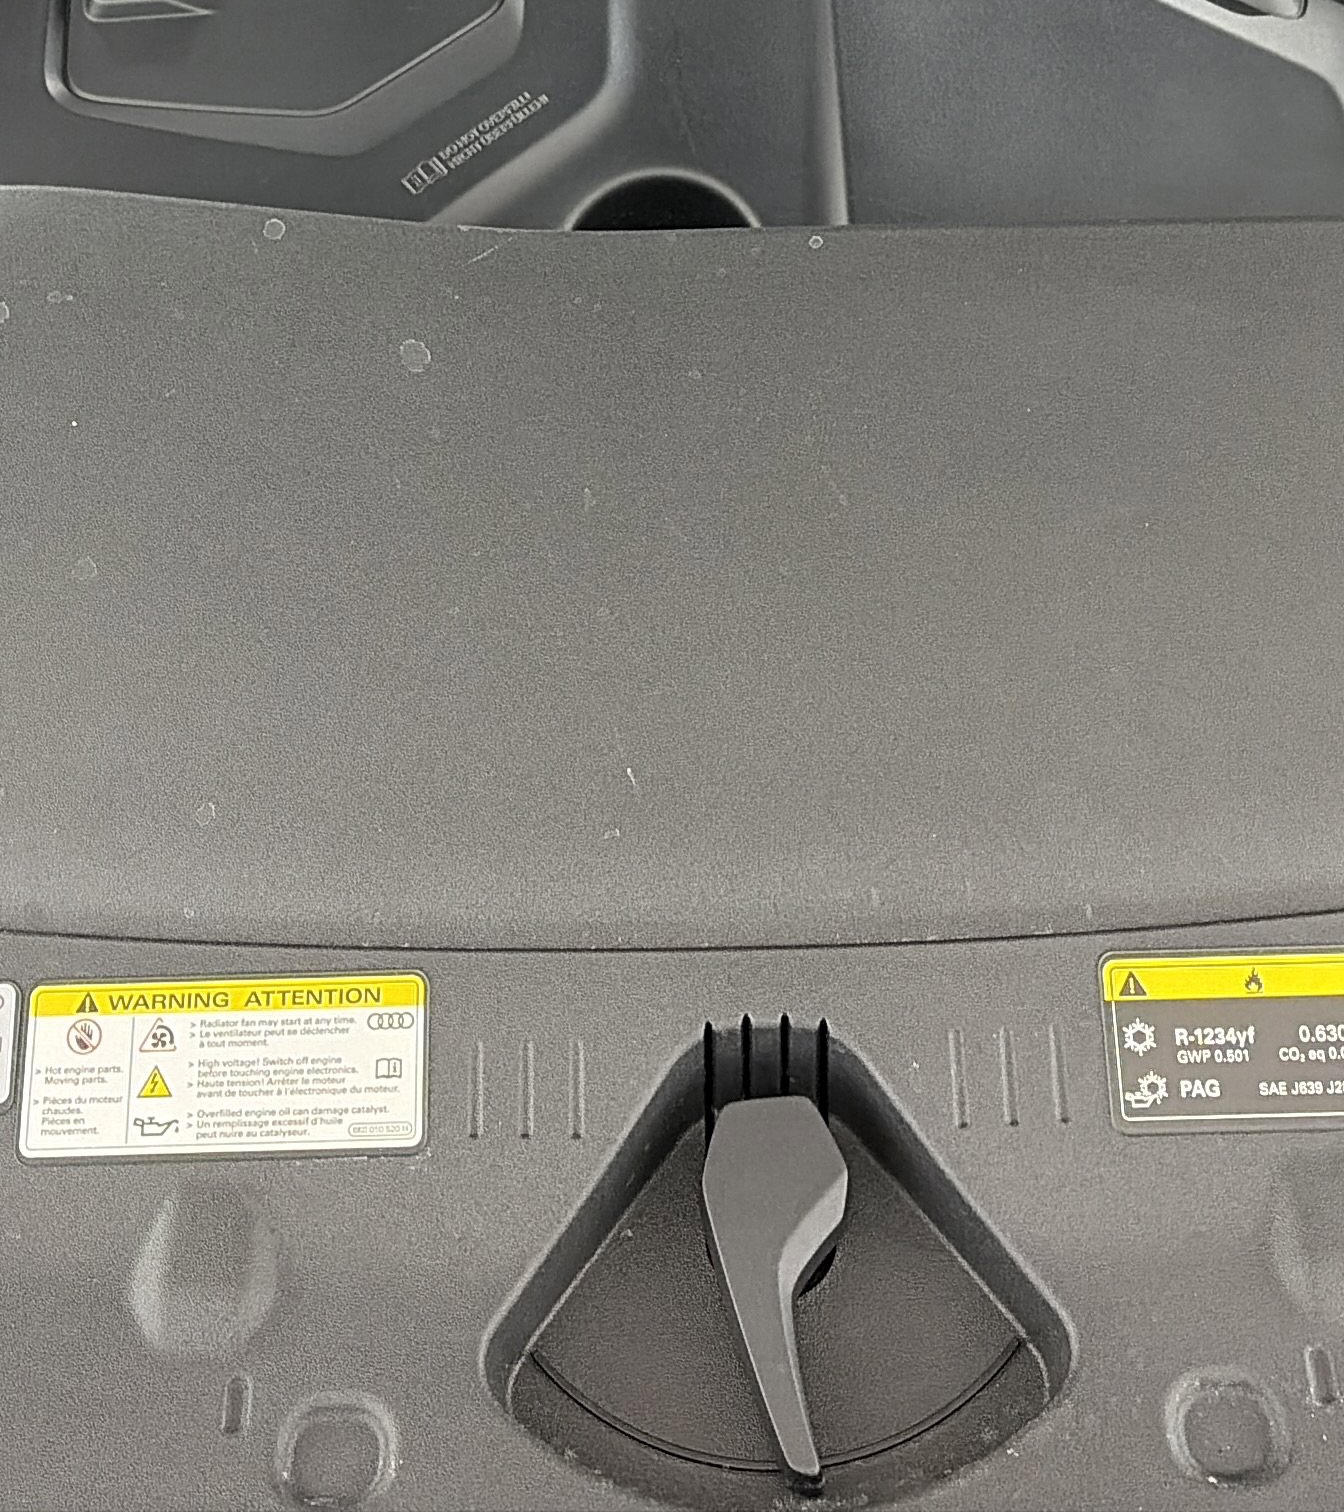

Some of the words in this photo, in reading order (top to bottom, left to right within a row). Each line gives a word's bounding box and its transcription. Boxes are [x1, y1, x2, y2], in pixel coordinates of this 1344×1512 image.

[108, 991, 230, 1012] WARNING
[244, 987, 382, 1008] ATTENTION
[200, 1020, 239, 1029] Radiator
[241, 1019, 256, 1027] fan
[258, 1019, 278, 1029] may
[280, 1018, 301, 1026] start
[303, 1017, 313, 1025] at
[315, 1018, 332, 1027] any
[333, 1016, 357, 1025] time.
[200, 1030, 211, 1038] Le
[213, 1028, 262, 1037] ventilateur
[264, 1028, 285, 1038] peut
[287, 1028, 298, 1036] se
[300, 1025, 350, 1035] déclencher
[1175, 1025, 1255, 1047] R-1234yf
[207, 1039, 226, 1048] tout
[228, 1039, 269, 1047] moment.
[1177, 1049, 1211, 1064] GWP
[1215, 1048, 1250, 1063] 0.501
[1309, 1048, 1326, 1063] eq
[198, 1059, 220, 1070] High
[222, 1058, 260, 1069] voltage!
[262, 1057, 294, 1066] Switch
[295, 1056, 309, 1065] off
[310, 1056, 342, 1066] engine
[45, 1066, 62, 1075] Hot
[64, 1065, 95, 1075] engine
[98, 1066, 124, 1075] parts.
[198, 1069, 228, 1078] before
[230, 1067, 271, 1078] touching
[272, 1067, 304, 1077] engine
[307, 1066, 359, 1075] electronics.
[45, 1076, 79, 1086] Moving
[82, 1076, 108, 1085] parts.
[197, 1079, 225, 1088] Haute
[227, 1078, 265, 1087] tension!
[301, 1076, 310, 1085] le
[312, 1076, 346, 1084] moteur
[197, 1089, 223, 1098] avant
[225, 1088, 236, 1097] de
[239, 1088, 274, 1097] toucher
[350, 1086, 362, 1094] du
[364, 1085, 400, 1094] moteur.
[1180, 1079, 1221, 1098] PAG
[1258, 1081, 1288, 1096] SAE
[1291, 1081, 1323, 1095] J639
[43, 1096, 72, 1105] Pièces
[75, 1095, 87, 1104] du
[89, 1096, 123, 1104] moteur
[42, 1106, 83, 1115] chaudes.
[197, 1109, 242, 1118] Overfilled
[244, 1108, 276, 1118] engine
[278, 1107, 290, 1116] oil
[293, 1108, 309, 1116] can
[311, 1106, 349, 1116] damage
[351, 1105, 390, 1115] catalyst.
[197, 1120, 211, 1128] Un
[213, 1118, 269, 1129] remplissage
[272, 1117, 309, 1126] excessif
[40, 1127, 99, 1136] mouvement.
[196, 1130, 217, 1140] peut
[219, 1129, 244, 1138] nuire
[245, 1129, 258, 1137] au
[260, 1128, 310, 1138] catalyseur.
